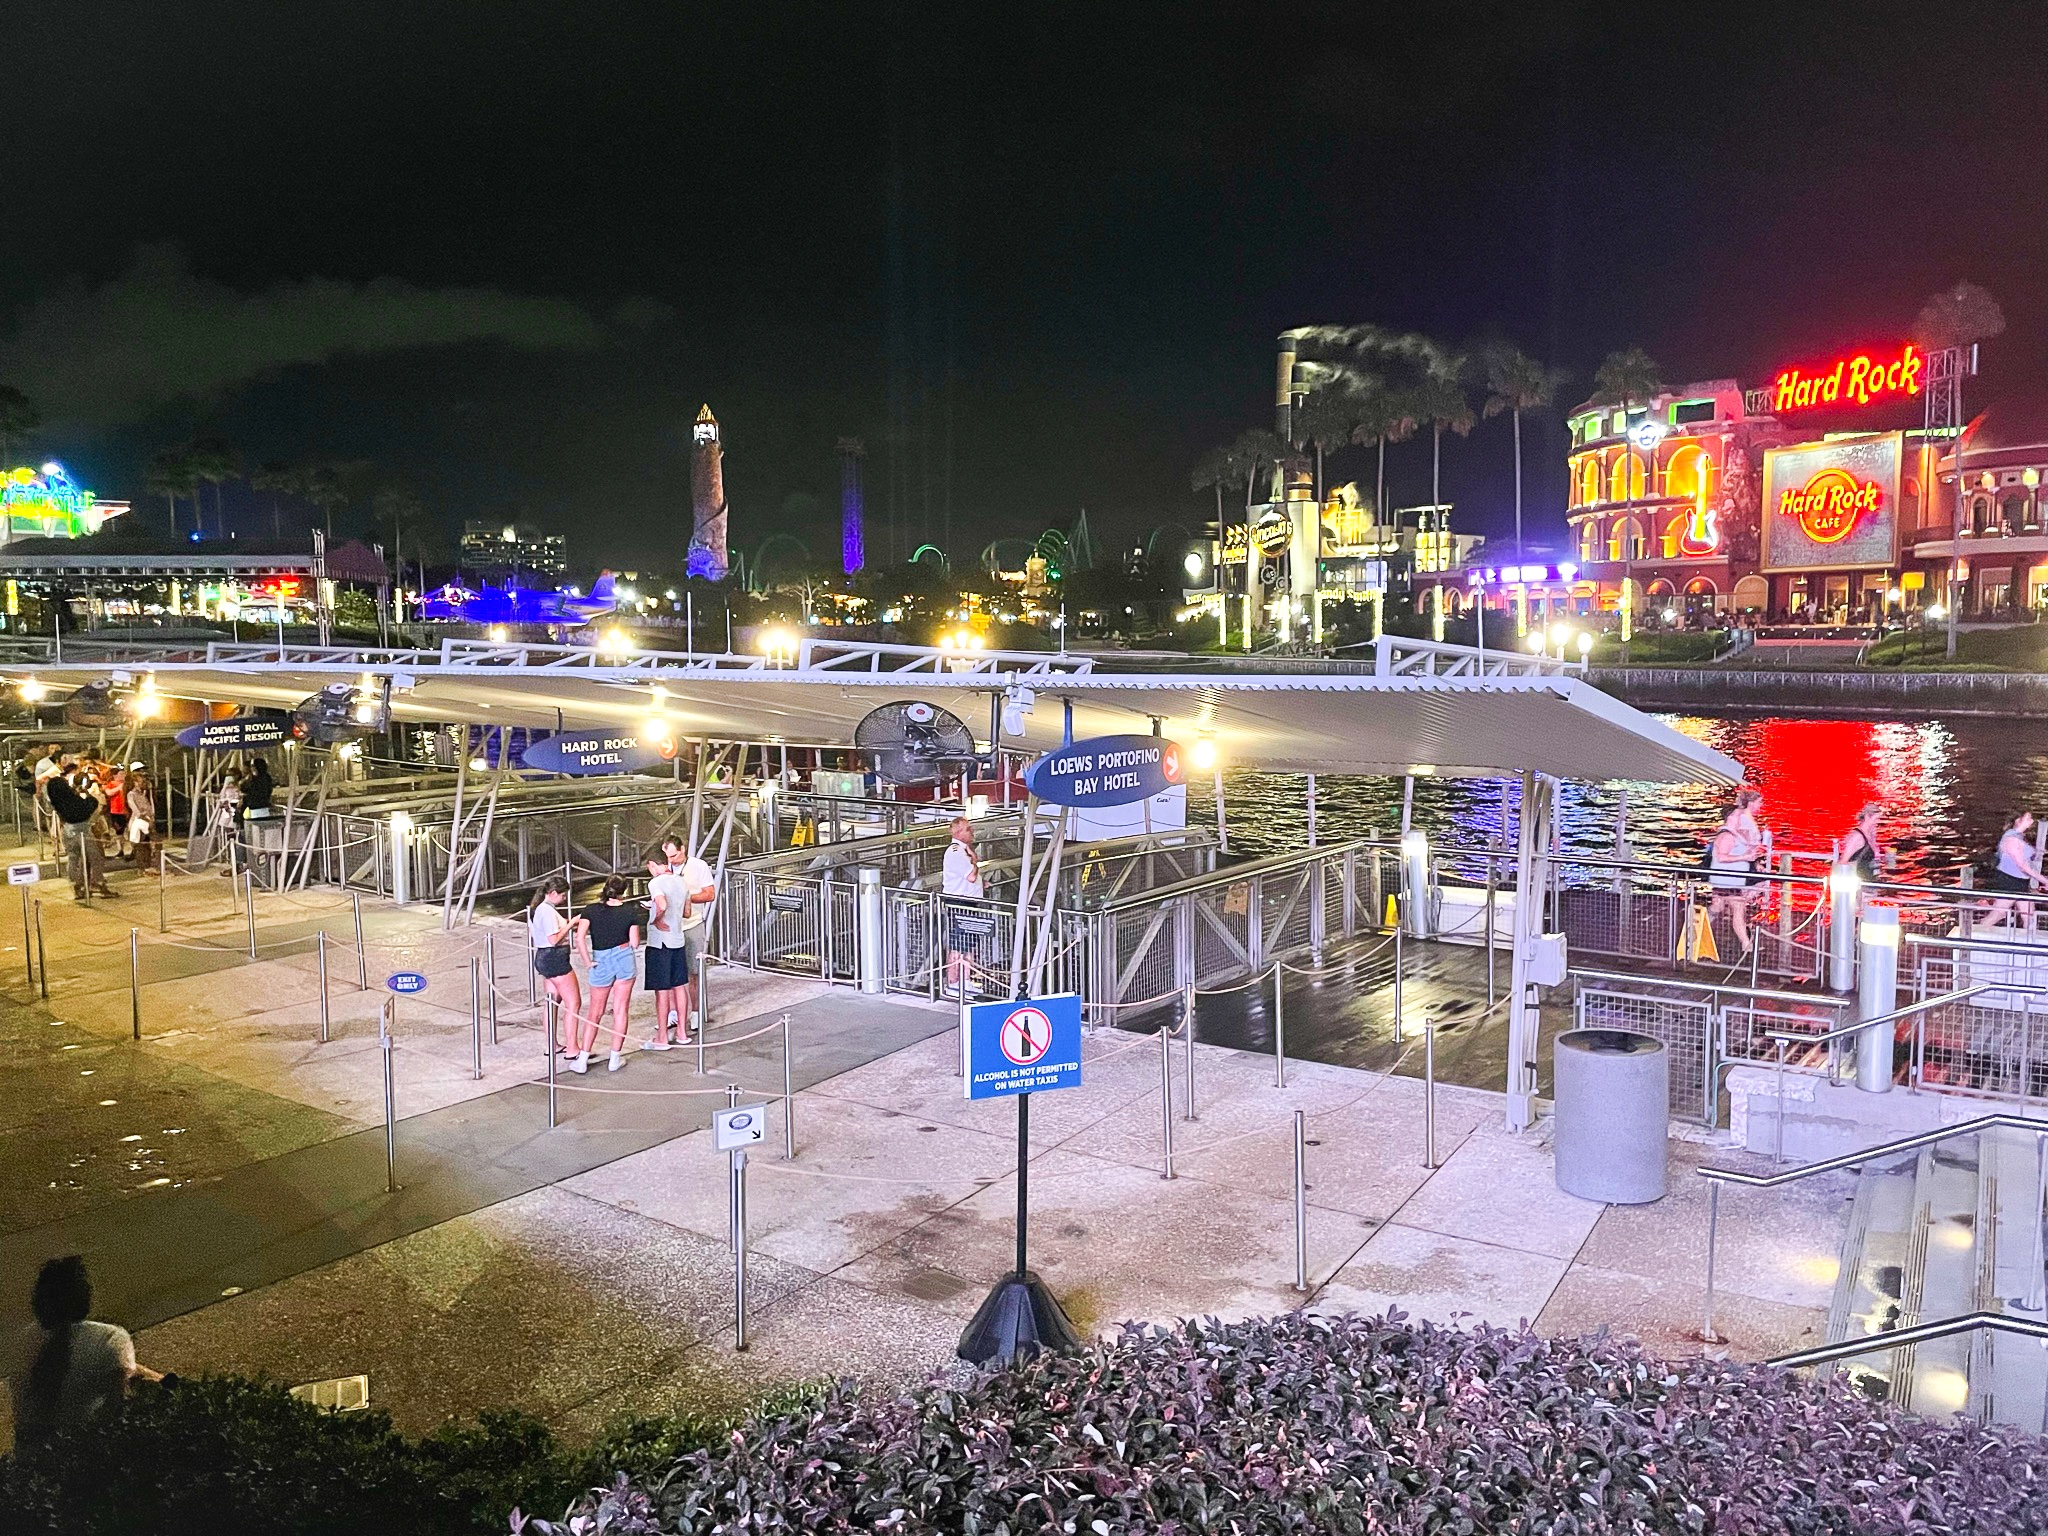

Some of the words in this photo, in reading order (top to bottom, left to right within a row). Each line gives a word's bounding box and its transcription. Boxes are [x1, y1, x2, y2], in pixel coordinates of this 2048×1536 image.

[1775, 361, 1844, 411] Hard
[1846, 346, 1921, 404] Rock
[1779, 486, 1828, 514] Hard
[1829, 481, 1877, 514] Rock
[1814, 517, 1840, 529] CAFE
[1315, 588, 1346, 603] andy
[204, 725, 240, 735] LOEWS
[245, 722, 279, 732] ROYAL
[200, 735, 240, 745] PACIFIC
[244, 731, 284, 742] RESORT
[561, 740, 598, 753] HARD
[604, 738, 637, 750] ROCK
[580, 752, 622, 766] HOTEL
[1050, 755, 1093, 776] LOEWS
[1098, 747, 1160, 770] PORTOFINO
[1074, 777, 1099, 796] BAY
[1104, 771, 1140, 792] HOTEL
[974, 1070, 1010, 1083] ALCOHOL
[1011, 1069, 1018, 1078] IS
[1020, 1067, 1035, 1077] NOT
[1036, 1062, 1078, 1075] PERMITTED
[994, 1081, 1007, 1091] ON
[1008, 1078, 1035, 1089] WATER
[1036, 1075, 1059, 1085] TAXIS
